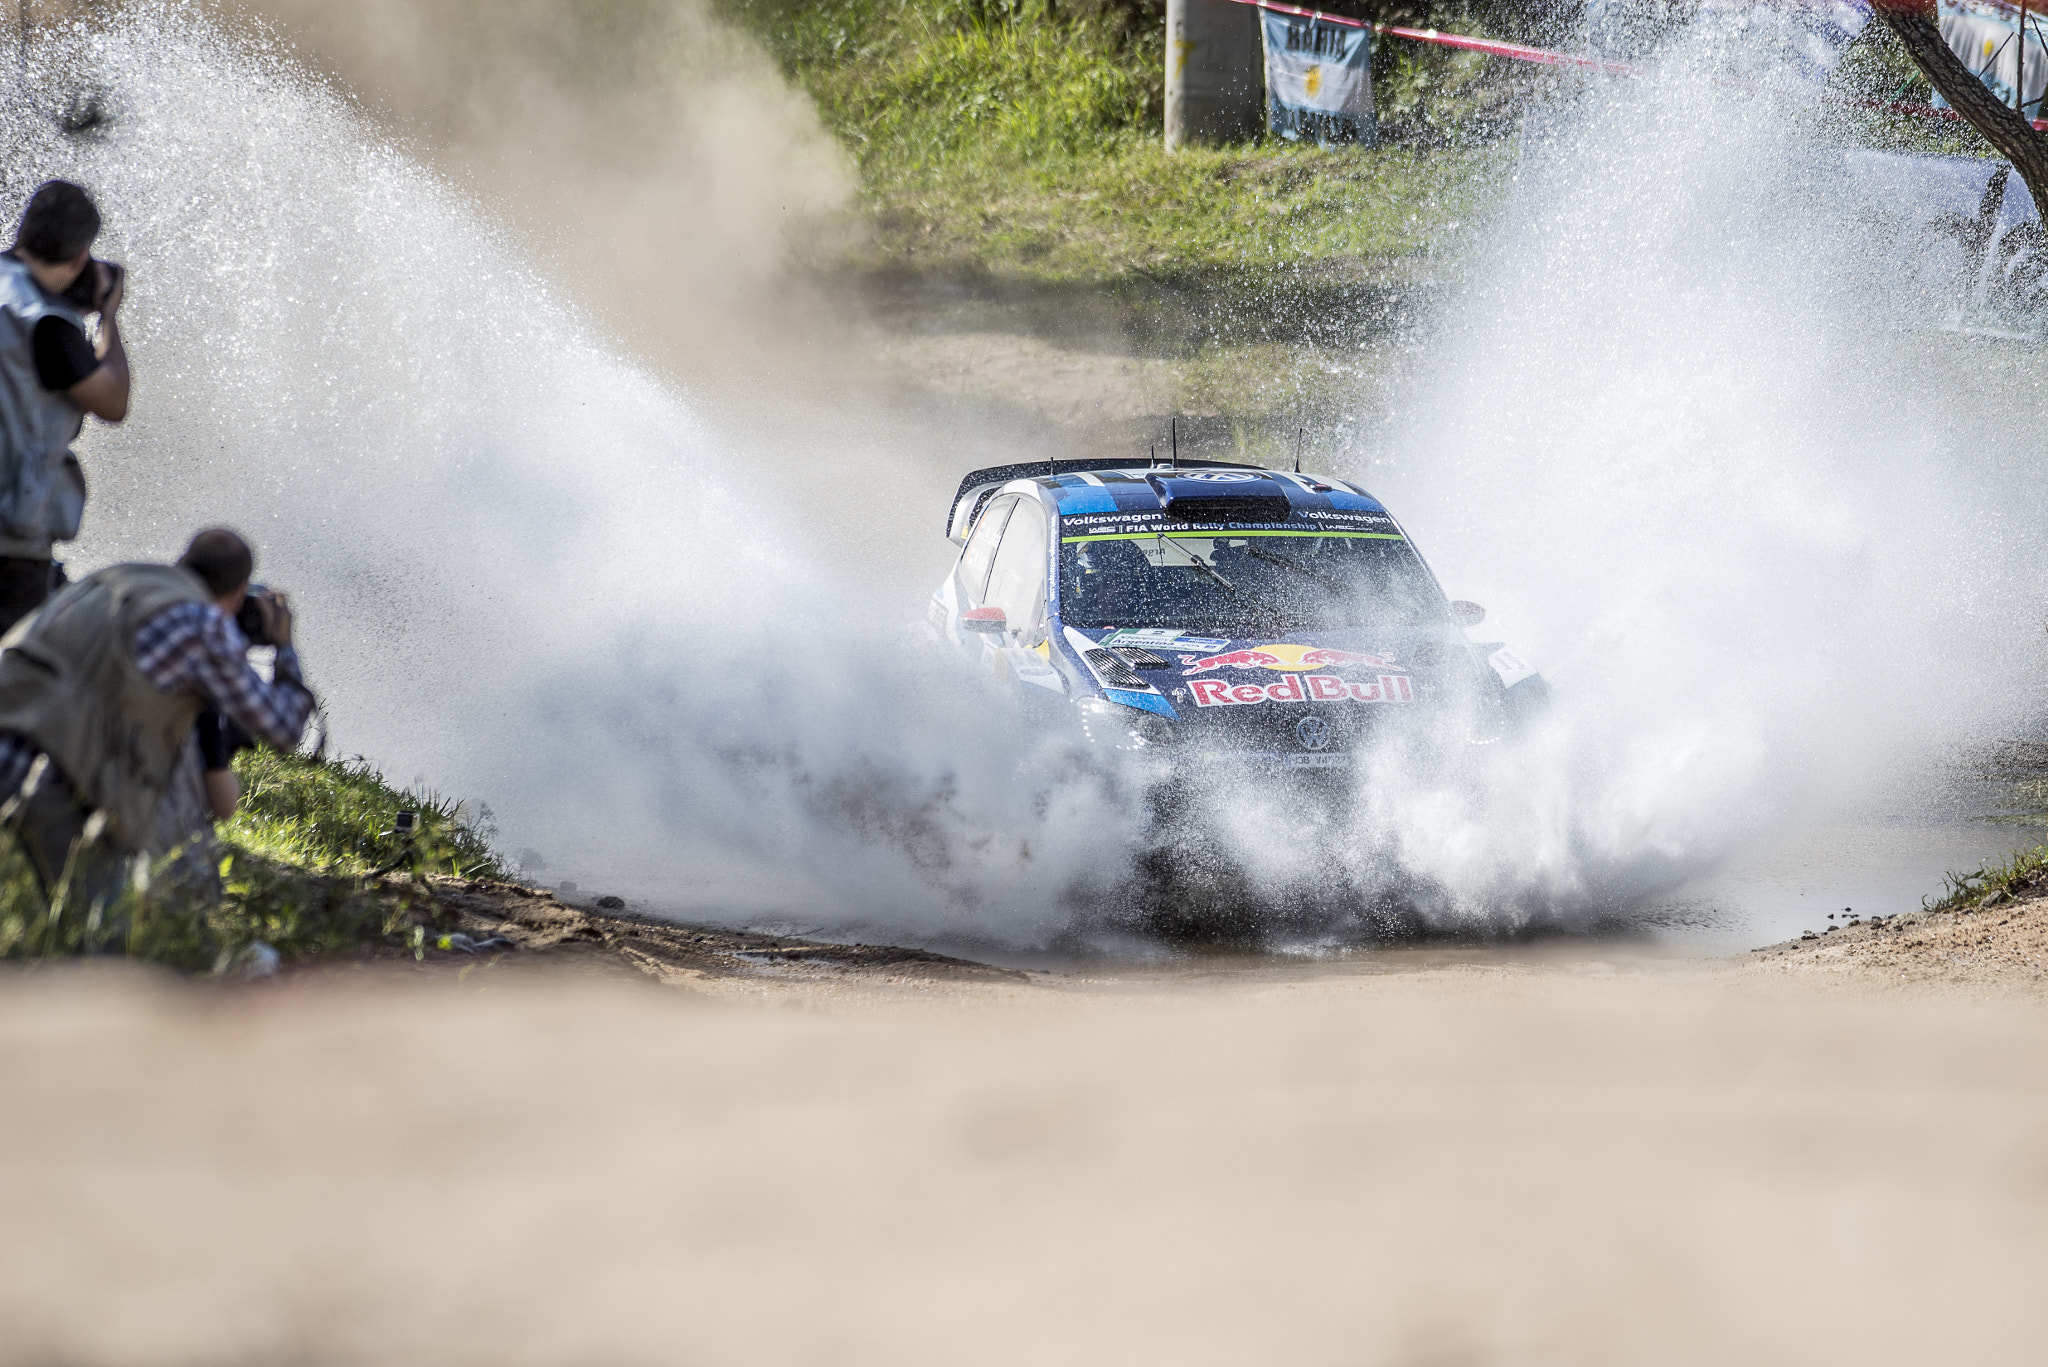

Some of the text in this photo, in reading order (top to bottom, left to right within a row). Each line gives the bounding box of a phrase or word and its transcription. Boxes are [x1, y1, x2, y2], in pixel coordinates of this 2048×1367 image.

[1063, 513, 1162, 526] Volkswagen
[1297, 511, 1391, 524] Volkswagen
[1126, 524, 1148, 533] FIA
[1151, 523, 1189, 531] World
[1193, 522, 1224, 531] Rally
[1228, 522, 1317, 531] Championship
[1113, 639, 1174, 647] Argentina
[1187, 674, 1413, 707] Red Bull
